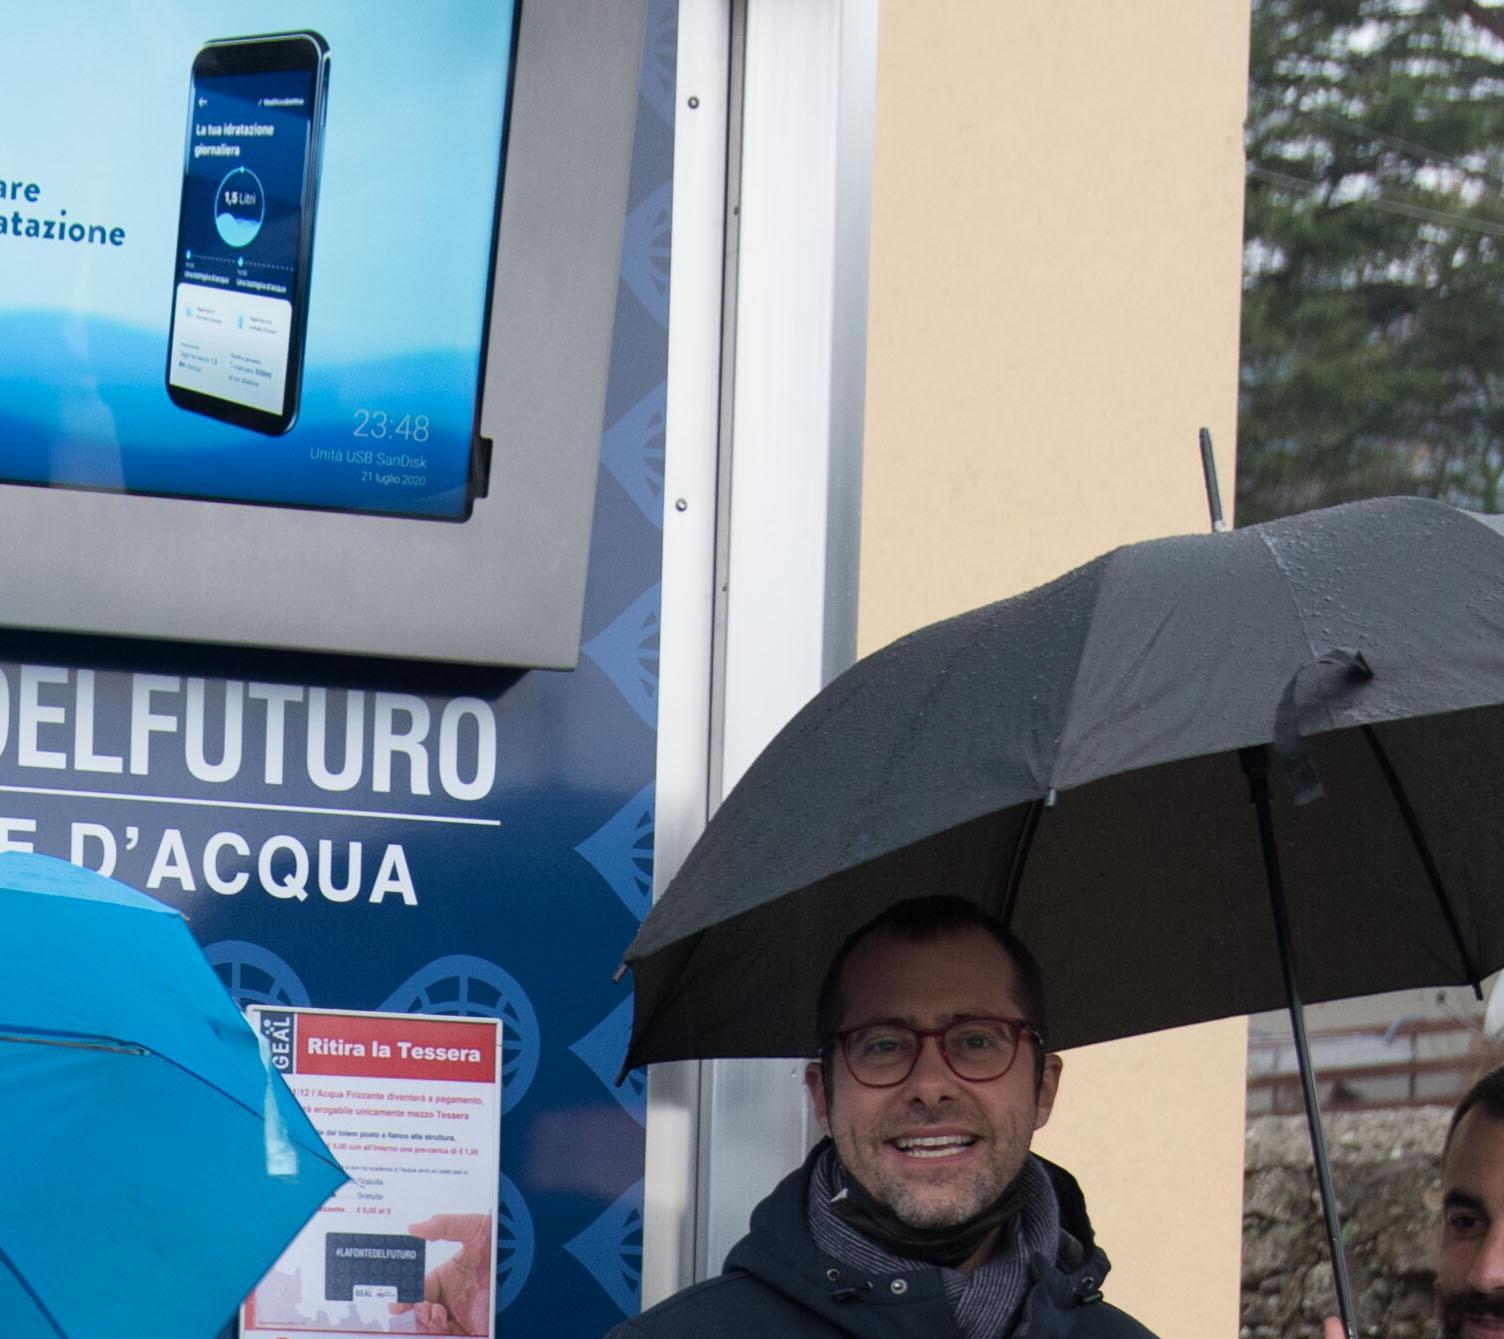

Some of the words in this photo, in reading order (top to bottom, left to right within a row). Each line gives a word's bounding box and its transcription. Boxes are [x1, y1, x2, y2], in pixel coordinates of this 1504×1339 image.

[195, 123, 207, 137] La
[209, 124, 222, 138] tua
[223, 122, 275, 137] idratazione
[194, 142, 240, 159] giornaliera
[352, 408, 431, 443] 23:48
[309, 447, 343, 463] Unità
[345, 450, 374, 465] USB
[375, 452, 429, 470] SanDisk
[361, 471, 373, 482] 21
[375, 472, 401, 486] luglio
[401, 474, 427, 487] 2020
[271, 1016, 291, 1070] GEAL
[307, 1036, 366, 1058] Ritira
[371, 1040, 392, 1059] la
[396, 1041, 481, 1063] Tessera
[346, 1090, 385, 1101] Frizzante
[387, 1091, 426, 1103] diventerà
[314, 1105, 354, 1117] erogabile
[355, 1107, 406, 1118] unicamente
[406, 1109, 435, 1119] mezzo
[436, 1110, 470, 1121] Tessera
